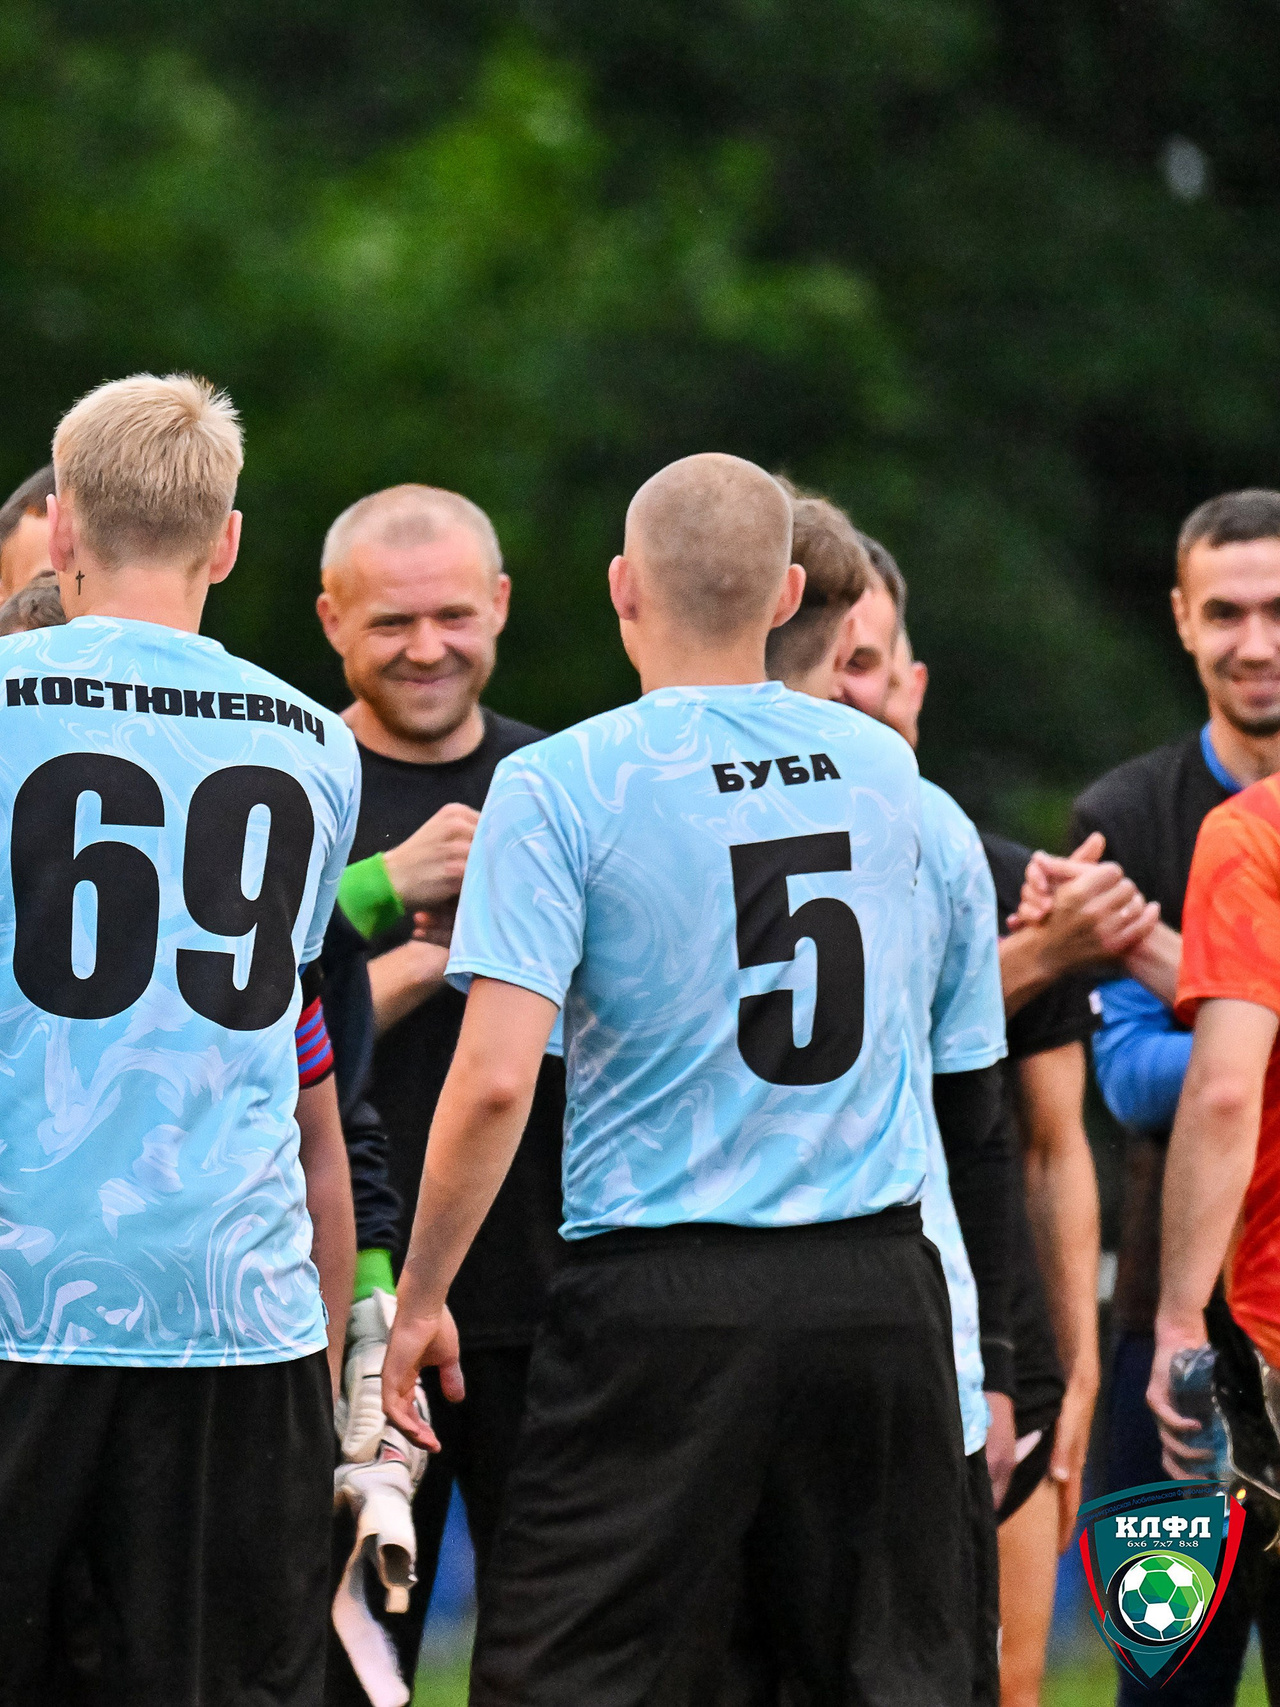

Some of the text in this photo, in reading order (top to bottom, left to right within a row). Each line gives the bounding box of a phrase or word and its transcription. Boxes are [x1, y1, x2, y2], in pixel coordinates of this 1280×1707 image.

[6, 676, 326, 746] КОСТЮКЕВИЧ
[711, 753, 841, 793] БУБА
[10, 752, 315, 1032] 69
[729, 831, 865, 1086] 5
